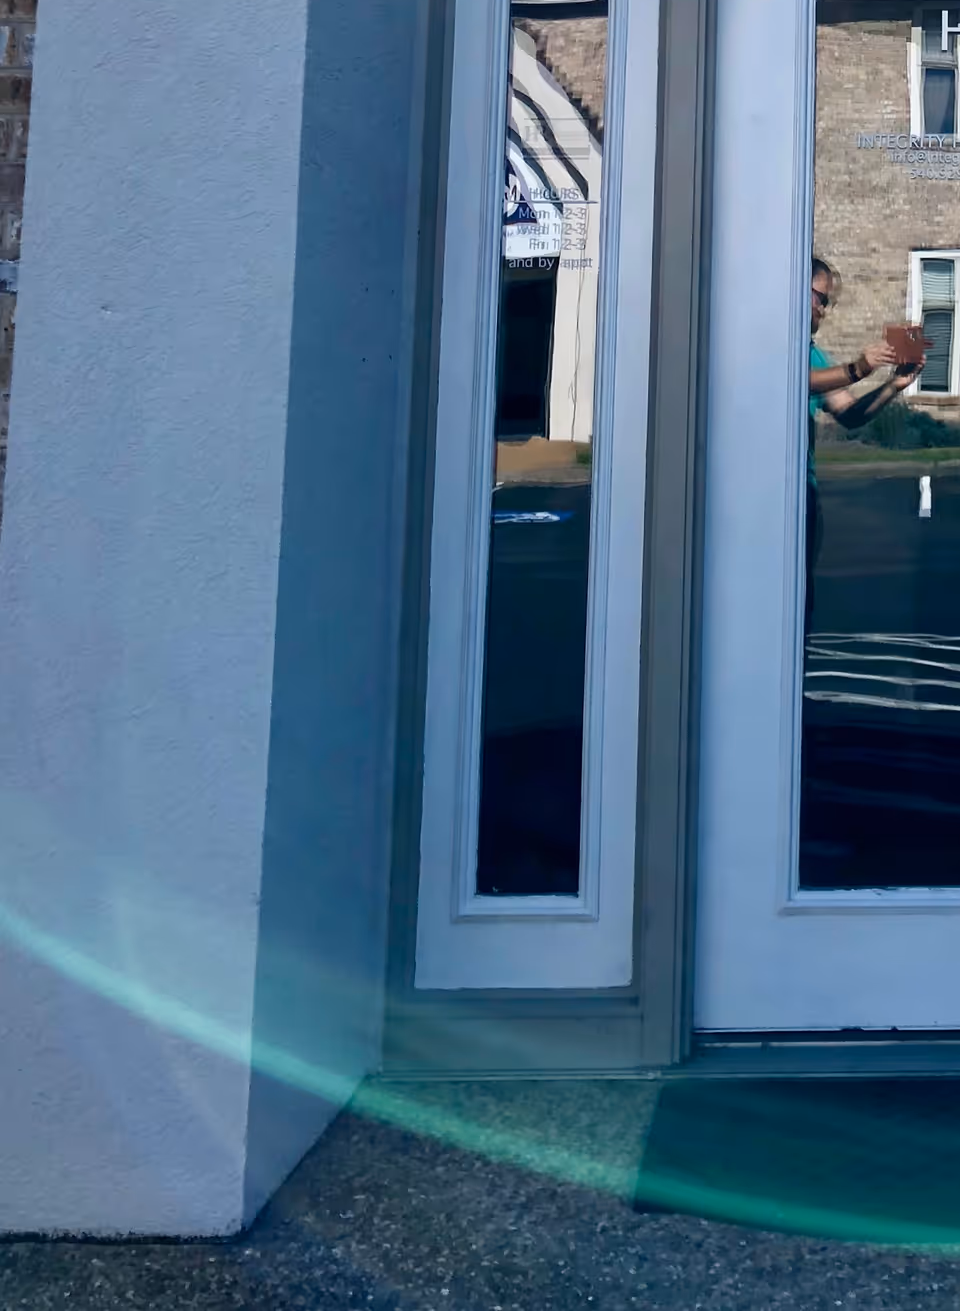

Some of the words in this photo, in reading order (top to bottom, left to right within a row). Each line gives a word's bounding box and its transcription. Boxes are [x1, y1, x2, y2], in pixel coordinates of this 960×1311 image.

[856, 133, 946, 150] INTEGRITY
[529, 187, 579, 200] HOURS
[518, 206, 550, 219] Mon
[529, 238, 549, 251] Fri
[509, 258, 533, 269] and
[538, 257, 555, 271] by
